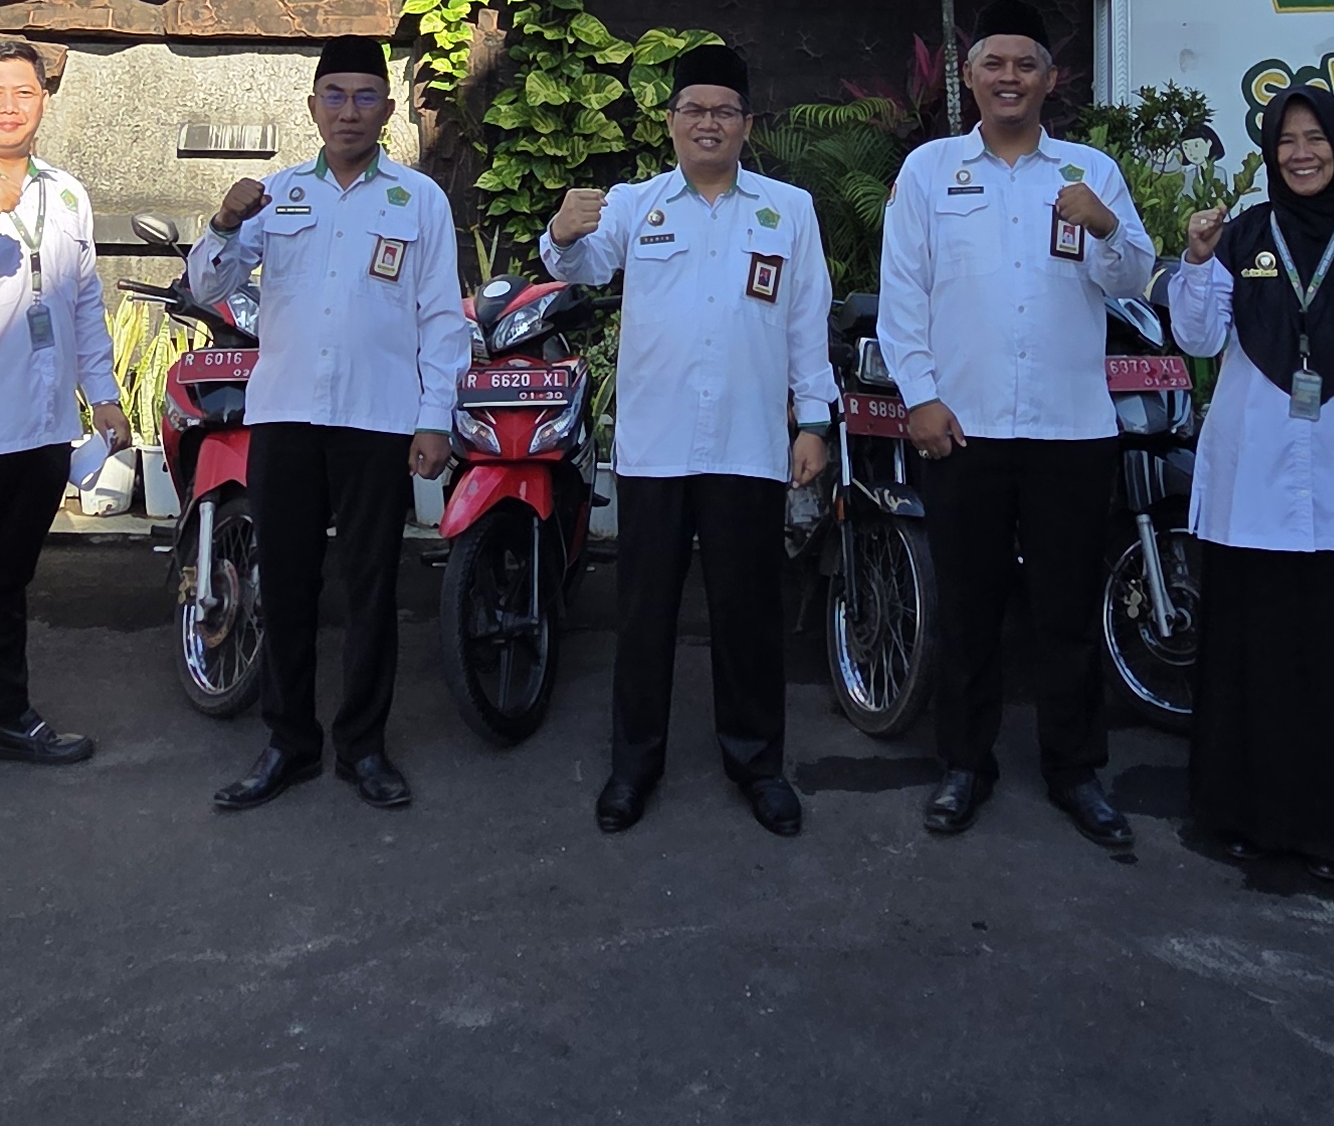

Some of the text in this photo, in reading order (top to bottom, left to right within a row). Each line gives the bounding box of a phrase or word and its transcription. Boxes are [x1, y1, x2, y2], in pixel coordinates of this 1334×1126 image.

[185, 352, 243, 366] R 6016
[1109, 359, 1181, 375] 6373 XL
[467, 373, 563, 388] R 6620 XL
[849, 398, 906, 419] R 9896
